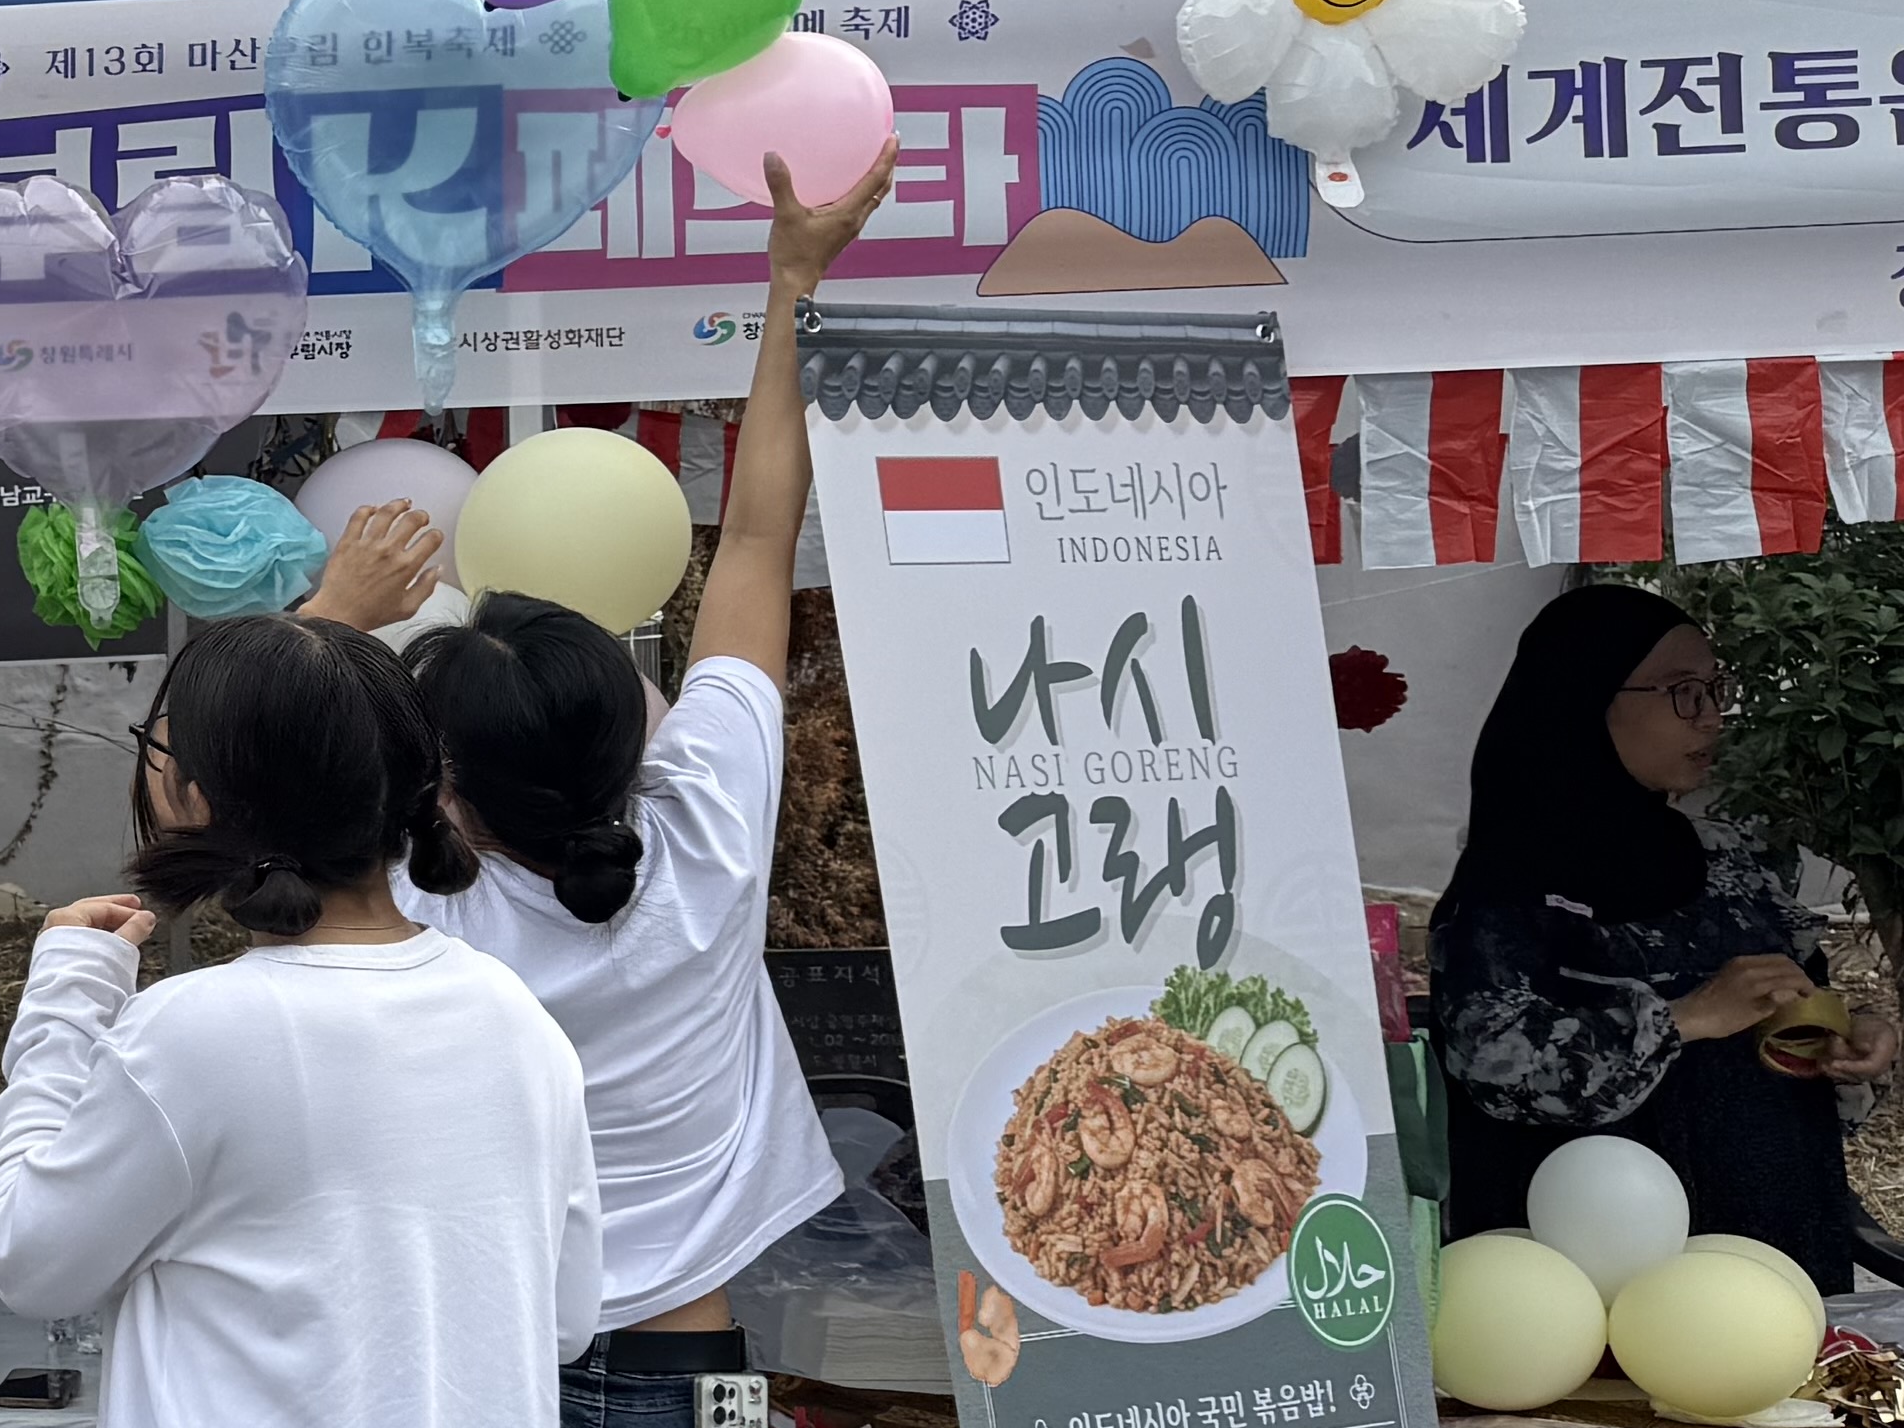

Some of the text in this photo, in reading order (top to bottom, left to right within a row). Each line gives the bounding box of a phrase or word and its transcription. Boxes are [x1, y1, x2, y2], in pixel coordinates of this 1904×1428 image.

[44, 42, 165, 80] 제13회
[839, 5, 911, 40] 축제
[513, 105, 1020, 262] 페타
[458, 327, 625, 353] 시상권활성화재단
[1026, 462, 1227, 521] 인도네시아
[1058, 535, 1223, 564] INDONESIA
[969, 595, 1216, 747] 나시
[974, 745, 1240, 790] NASI GORENG
[998, 785, 1236, 971] 고랭
[1303, 1236, 1386, 1300] حلال
[1313, 1296, 1384, 1320] HALAL
[1252, 1379, 1337, 1425] 볶음밥!
